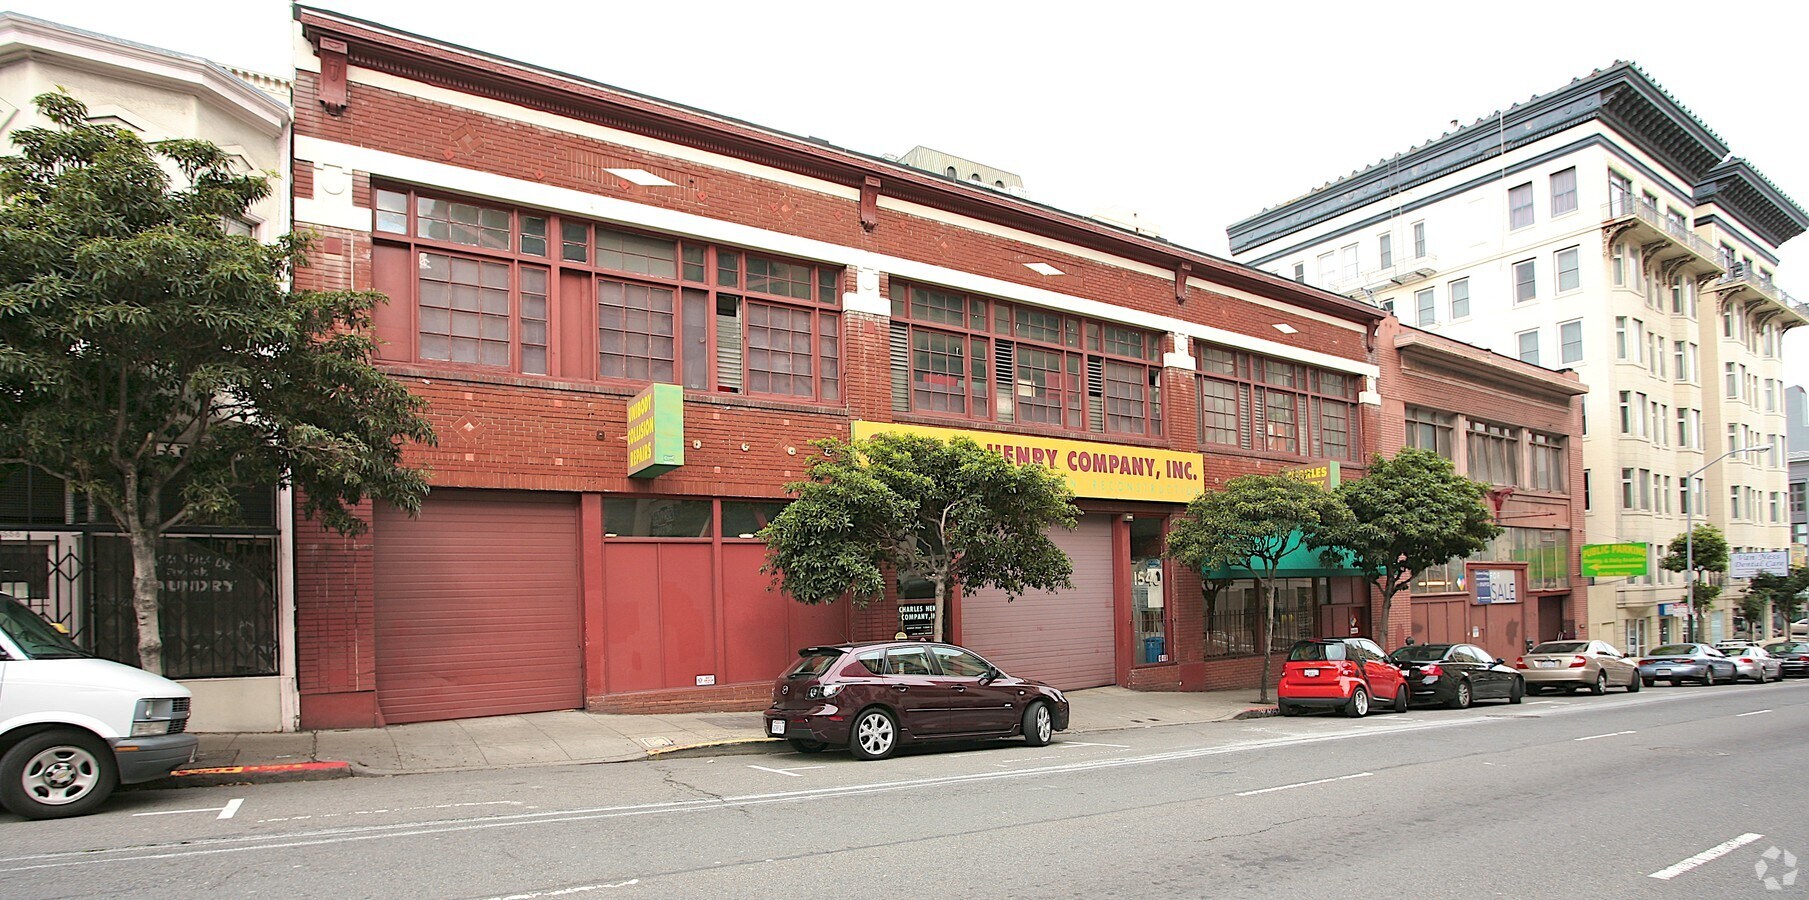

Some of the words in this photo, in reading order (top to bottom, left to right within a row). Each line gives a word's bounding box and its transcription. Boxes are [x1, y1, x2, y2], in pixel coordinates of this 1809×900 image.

[628, 393, 652, 423] UNIBODY
[628, 416, 654, 446] COLLISION
[630, 441, 652, 467] REPAIRS
[1066, 450, 1161, 480] COMPANY,
[1165, 459, 1199, 481] INC.
[1582, 545, 1610, 559] PUBLIC
[1611, 544, 1647, 557] PARKING
[157, 580, 238, 593] AUNDRY
[1133, 571, 1162, 587] 1540
[1491, 583, 1515, 601] SALE
[898, 605, 924, 613] CHARLES
